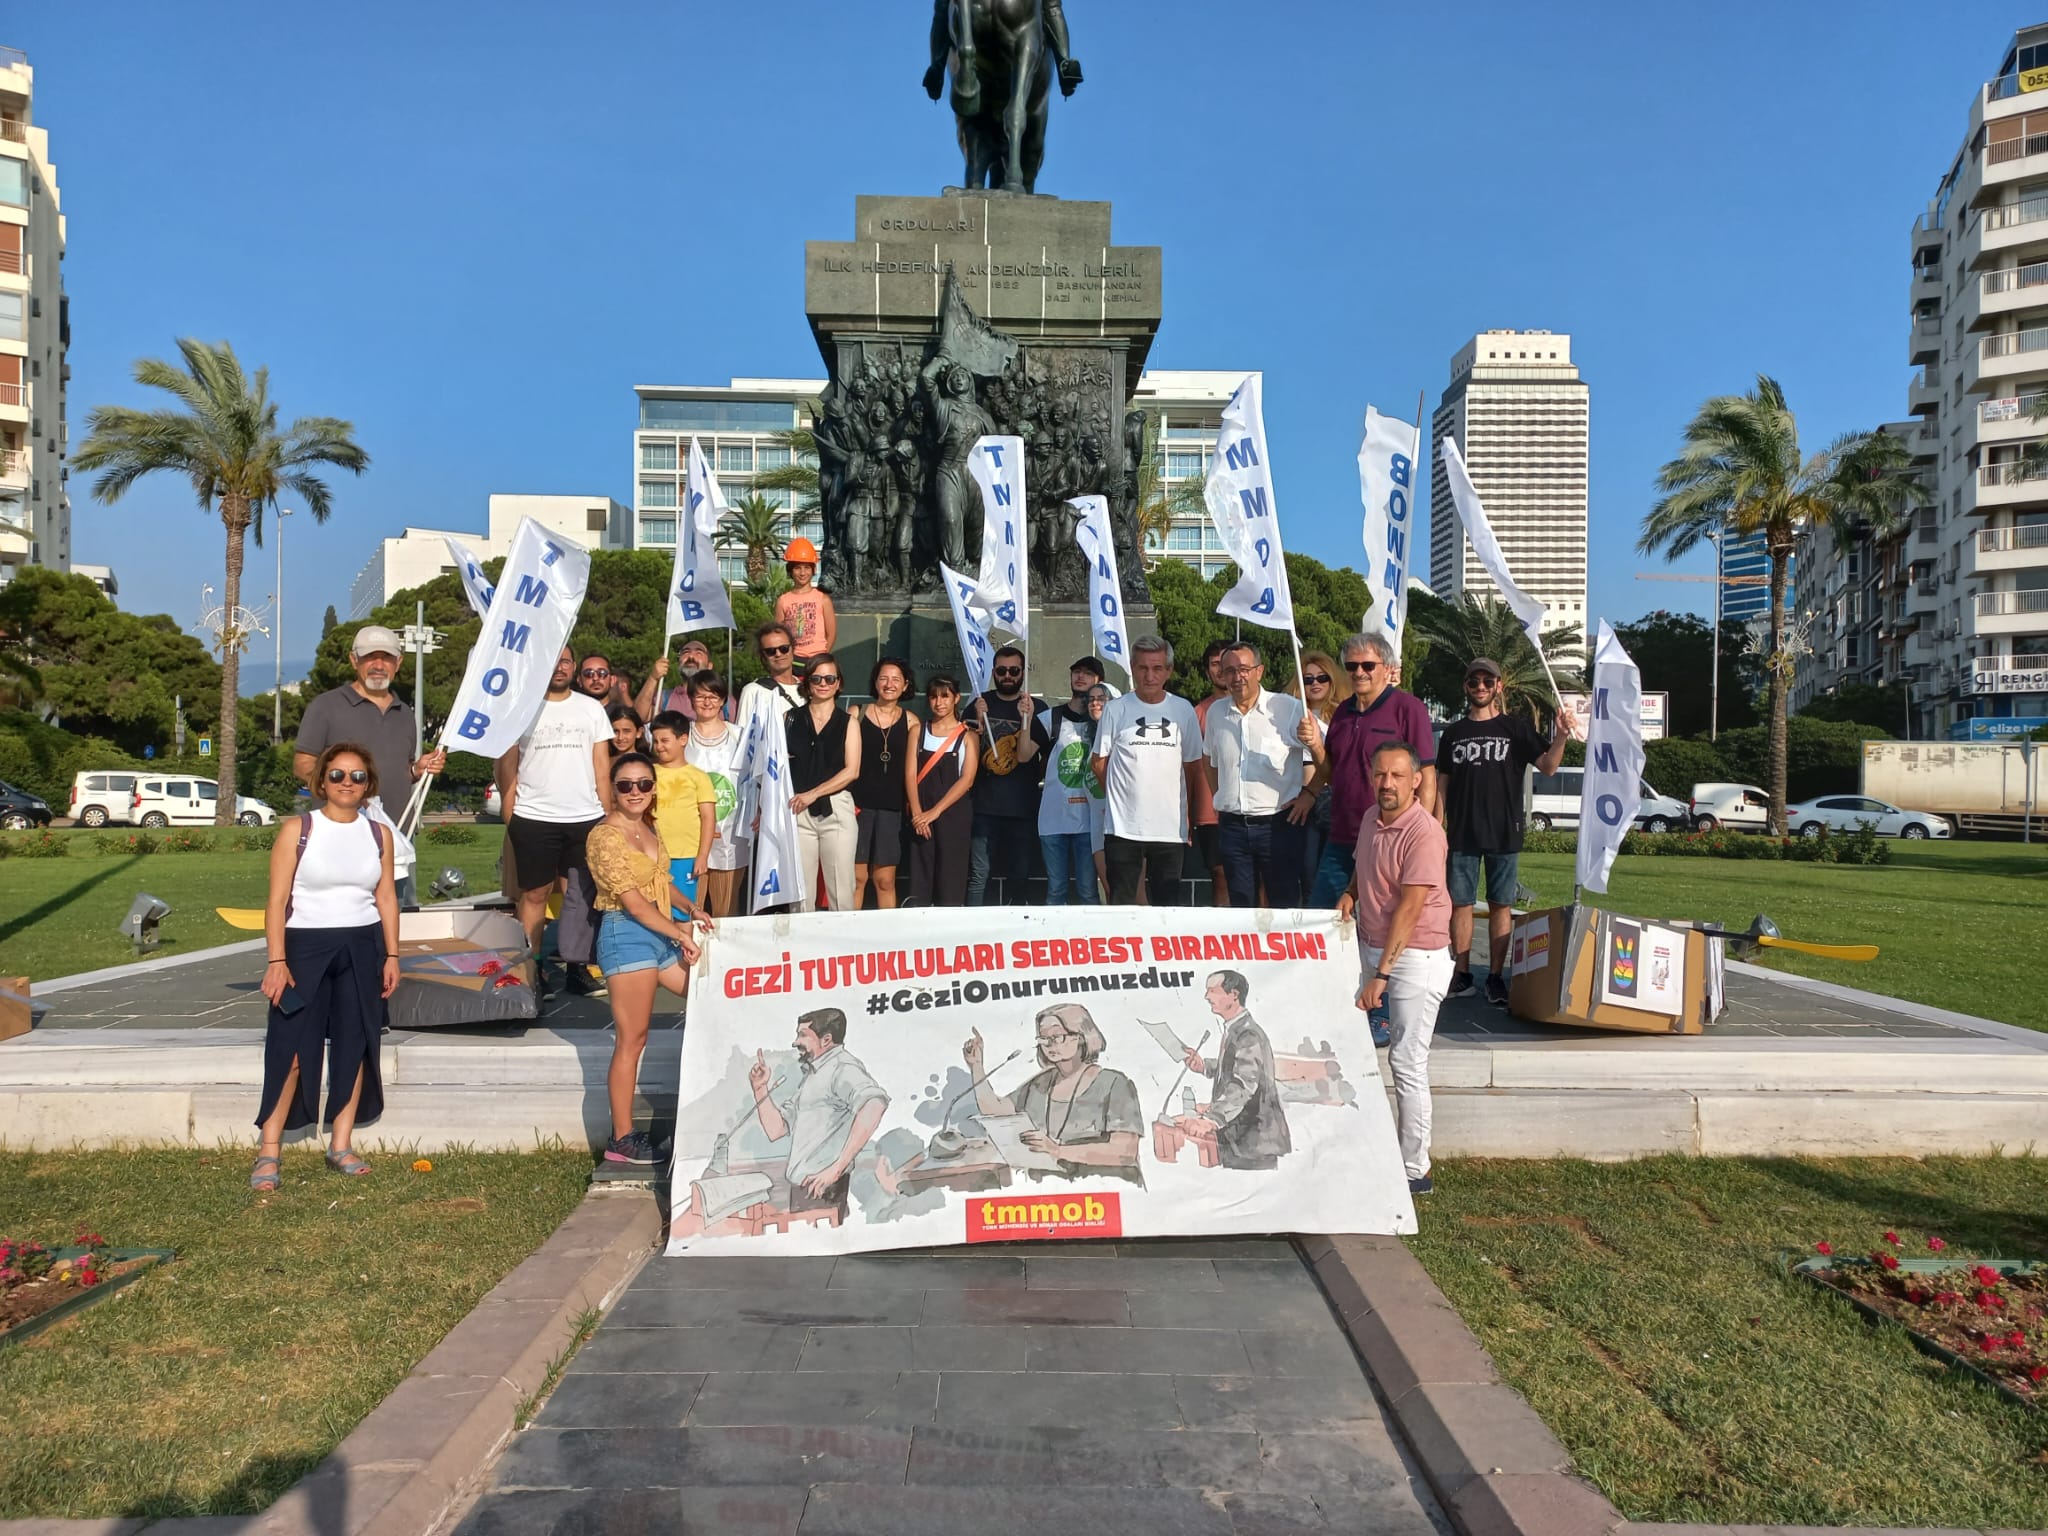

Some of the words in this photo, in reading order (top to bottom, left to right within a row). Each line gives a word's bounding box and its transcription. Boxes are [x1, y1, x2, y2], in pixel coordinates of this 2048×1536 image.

[881, 218, 977, 233] ORDULAR!
[457, 539, 565, 741] TMMOB
[723, 951, 791, 999] GEZİ
[799, 942, 1005, 992] TUTUKLULARI
[1011, 936, 1145, 969] SERBEST
[1150, 932, 1327, 961] BIRAKILSIN!
[866, 966, 1195, 1015] #GeziOnurumuzdur
[982, 1196, 1105, 1225] tmmob
